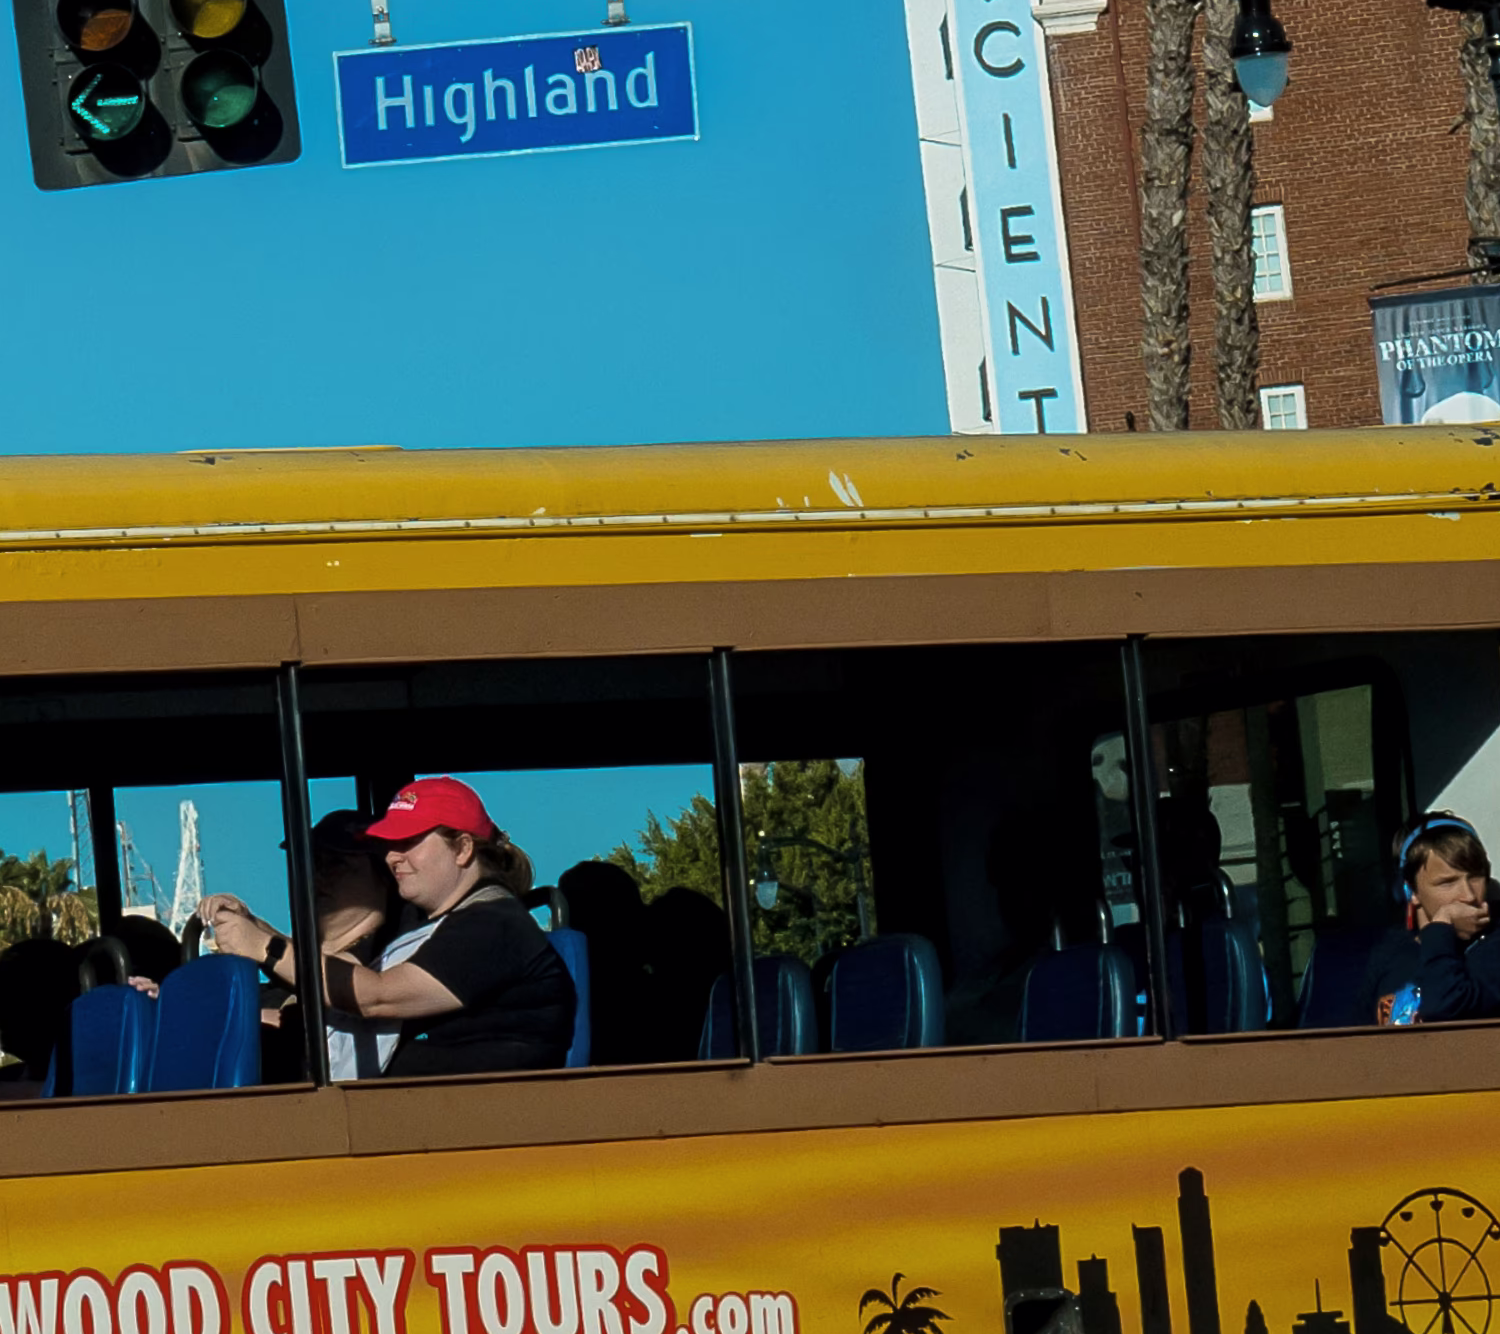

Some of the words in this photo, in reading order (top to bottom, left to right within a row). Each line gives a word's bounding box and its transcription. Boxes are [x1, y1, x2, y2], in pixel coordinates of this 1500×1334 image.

[375, 51, 659, 144] Highland
[1396, 359, 1416, 371] OF
[1417, 356, 1446, 369] THE
[1447, 351, 1493, 365] OPERA
